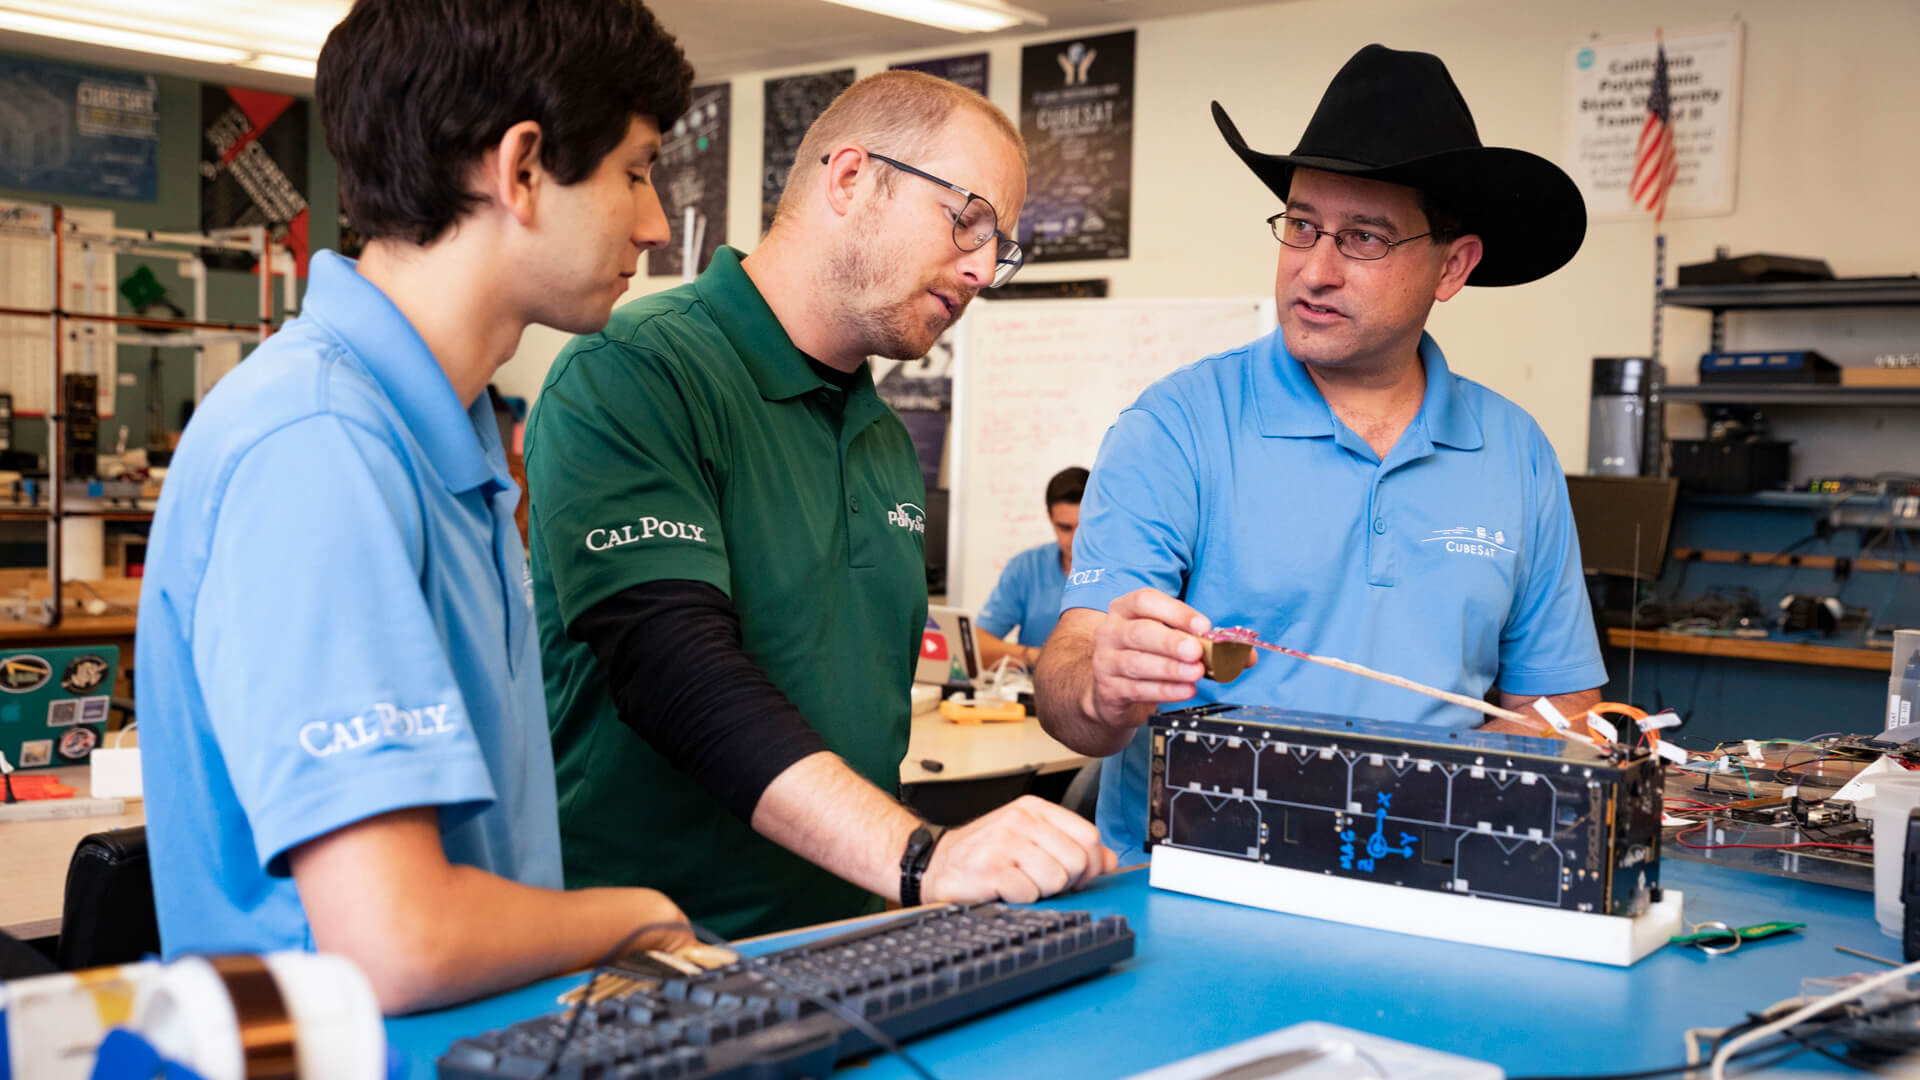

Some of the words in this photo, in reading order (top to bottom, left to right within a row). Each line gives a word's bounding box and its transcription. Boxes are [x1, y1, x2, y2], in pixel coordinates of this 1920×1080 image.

[585, 524, 640, 551] CAL
[639, 516, 707, 543] POLY
[298, 720, 380, 758] CAL
[374, 702, 455, 737] POLY
